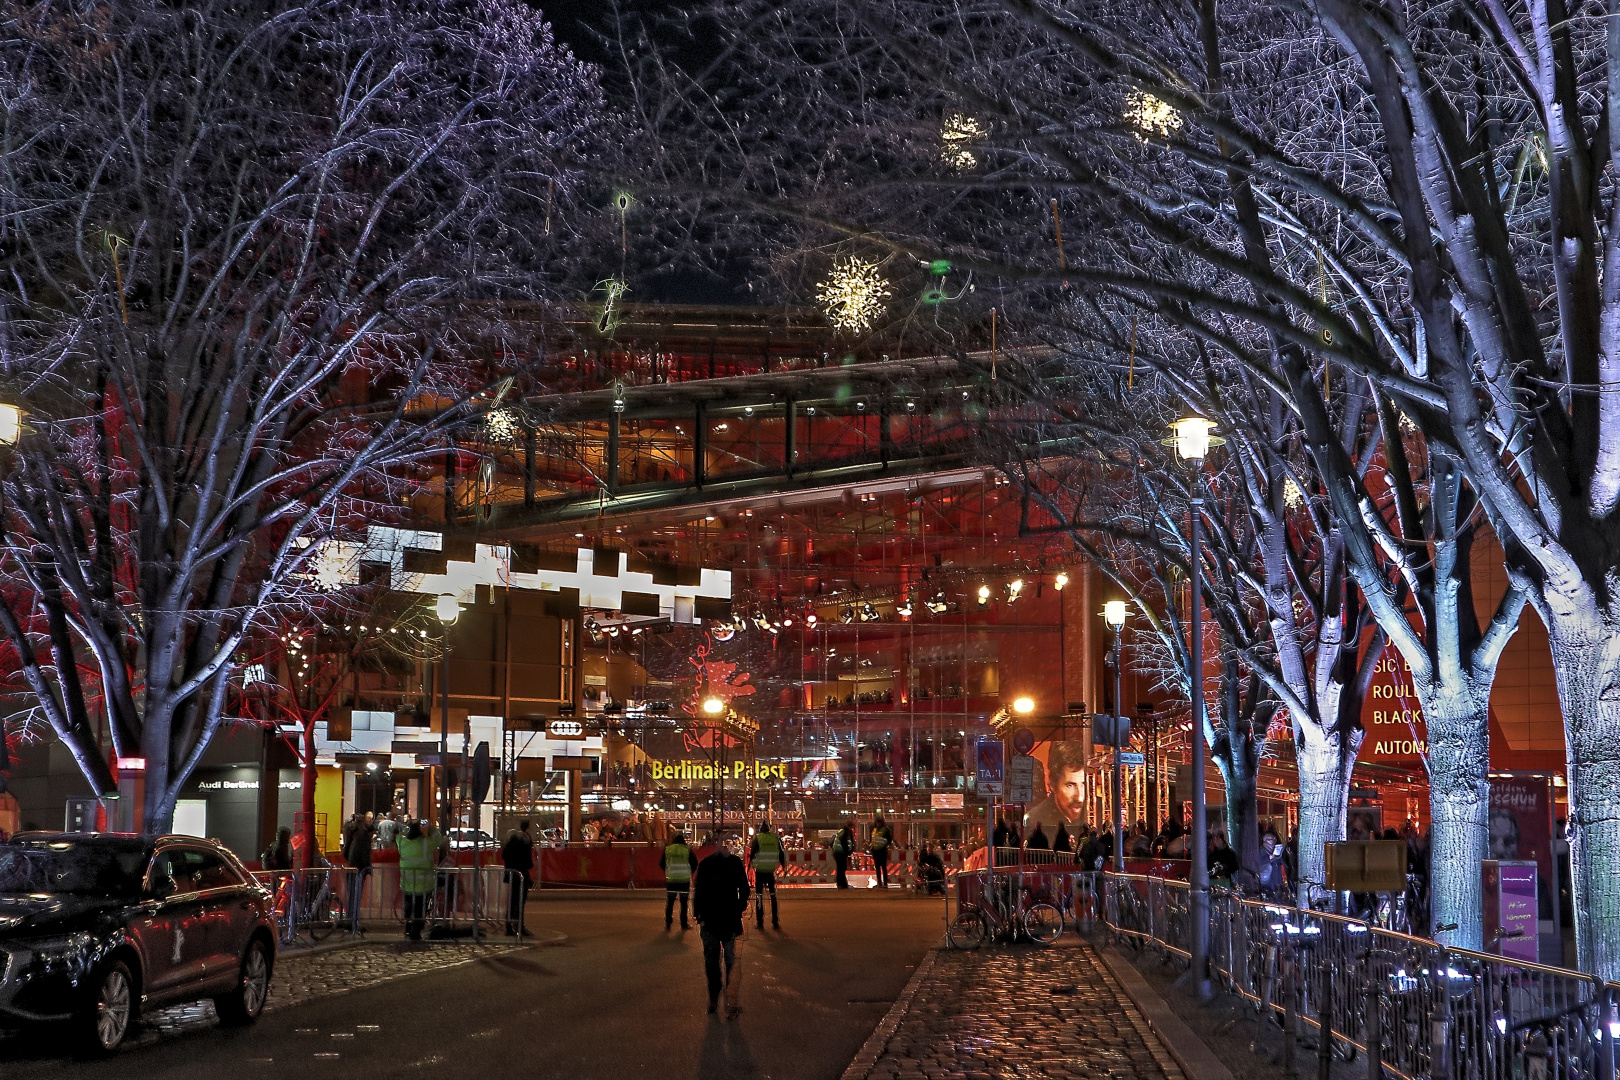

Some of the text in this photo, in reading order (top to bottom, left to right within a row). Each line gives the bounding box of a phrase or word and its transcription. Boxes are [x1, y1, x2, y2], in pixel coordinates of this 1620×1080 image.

[1373, 710, 1422, 725] BLACK
[652, 760, 786, 780] Berlinale Palast
[198, 781, 221, 789] Audi
[223, 781, 259, 789] Berlinal
[685, 811, 701, 820] AM
